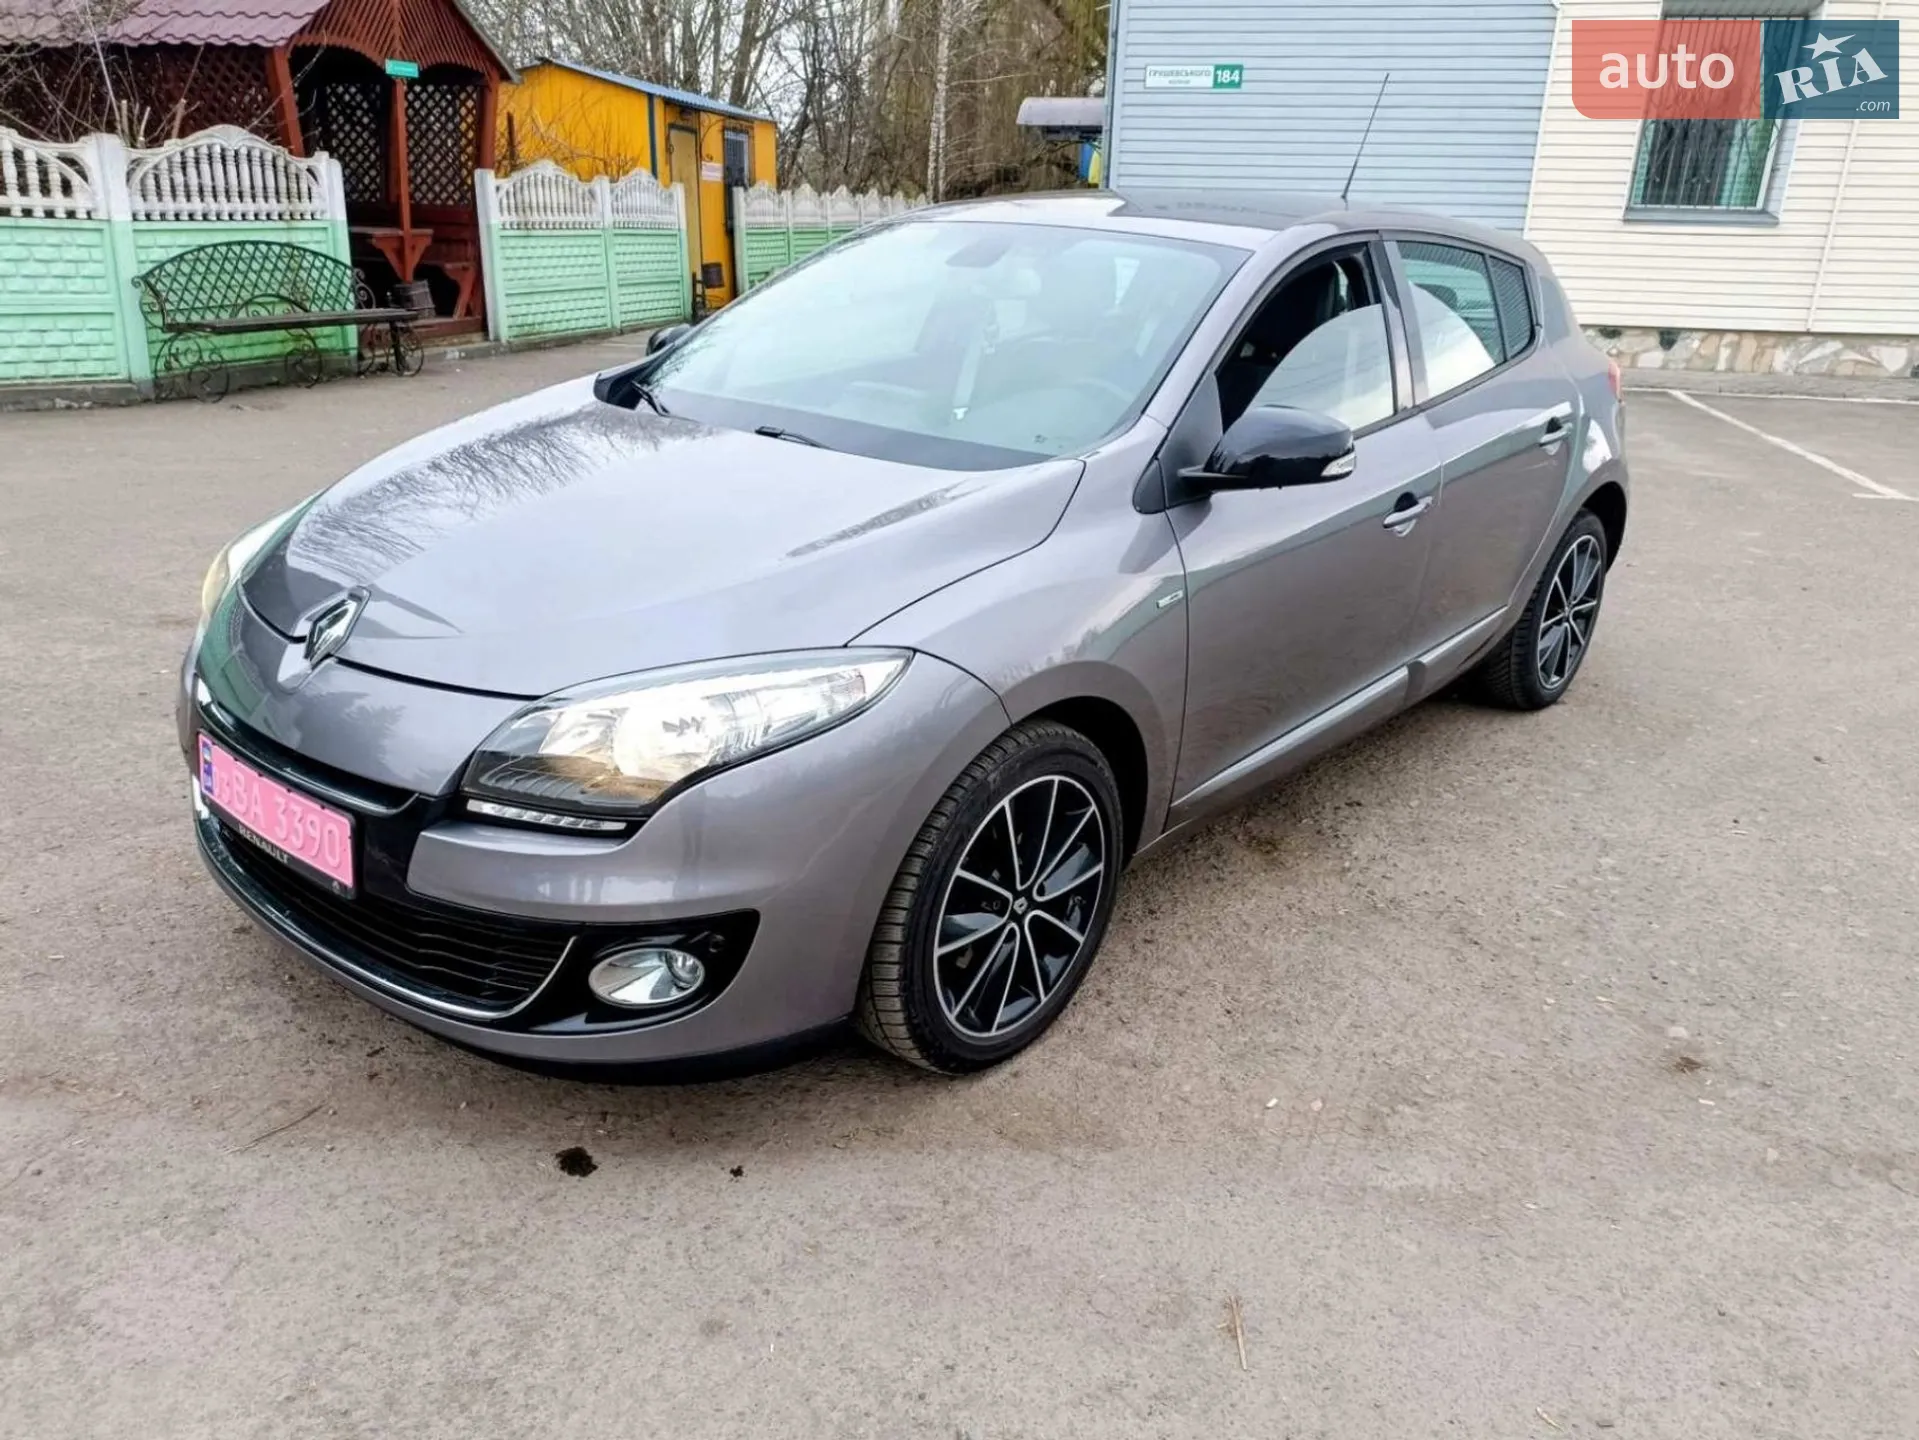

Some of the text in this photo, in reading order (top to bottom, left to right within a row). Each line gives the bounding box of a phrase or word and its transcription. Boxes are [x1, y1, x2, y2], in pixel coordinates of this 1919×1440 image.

[1216, 69, 1240, 84] 184
[238, 822, 288, 864] RENAULT
[273, 794, 341, 868] 3390
